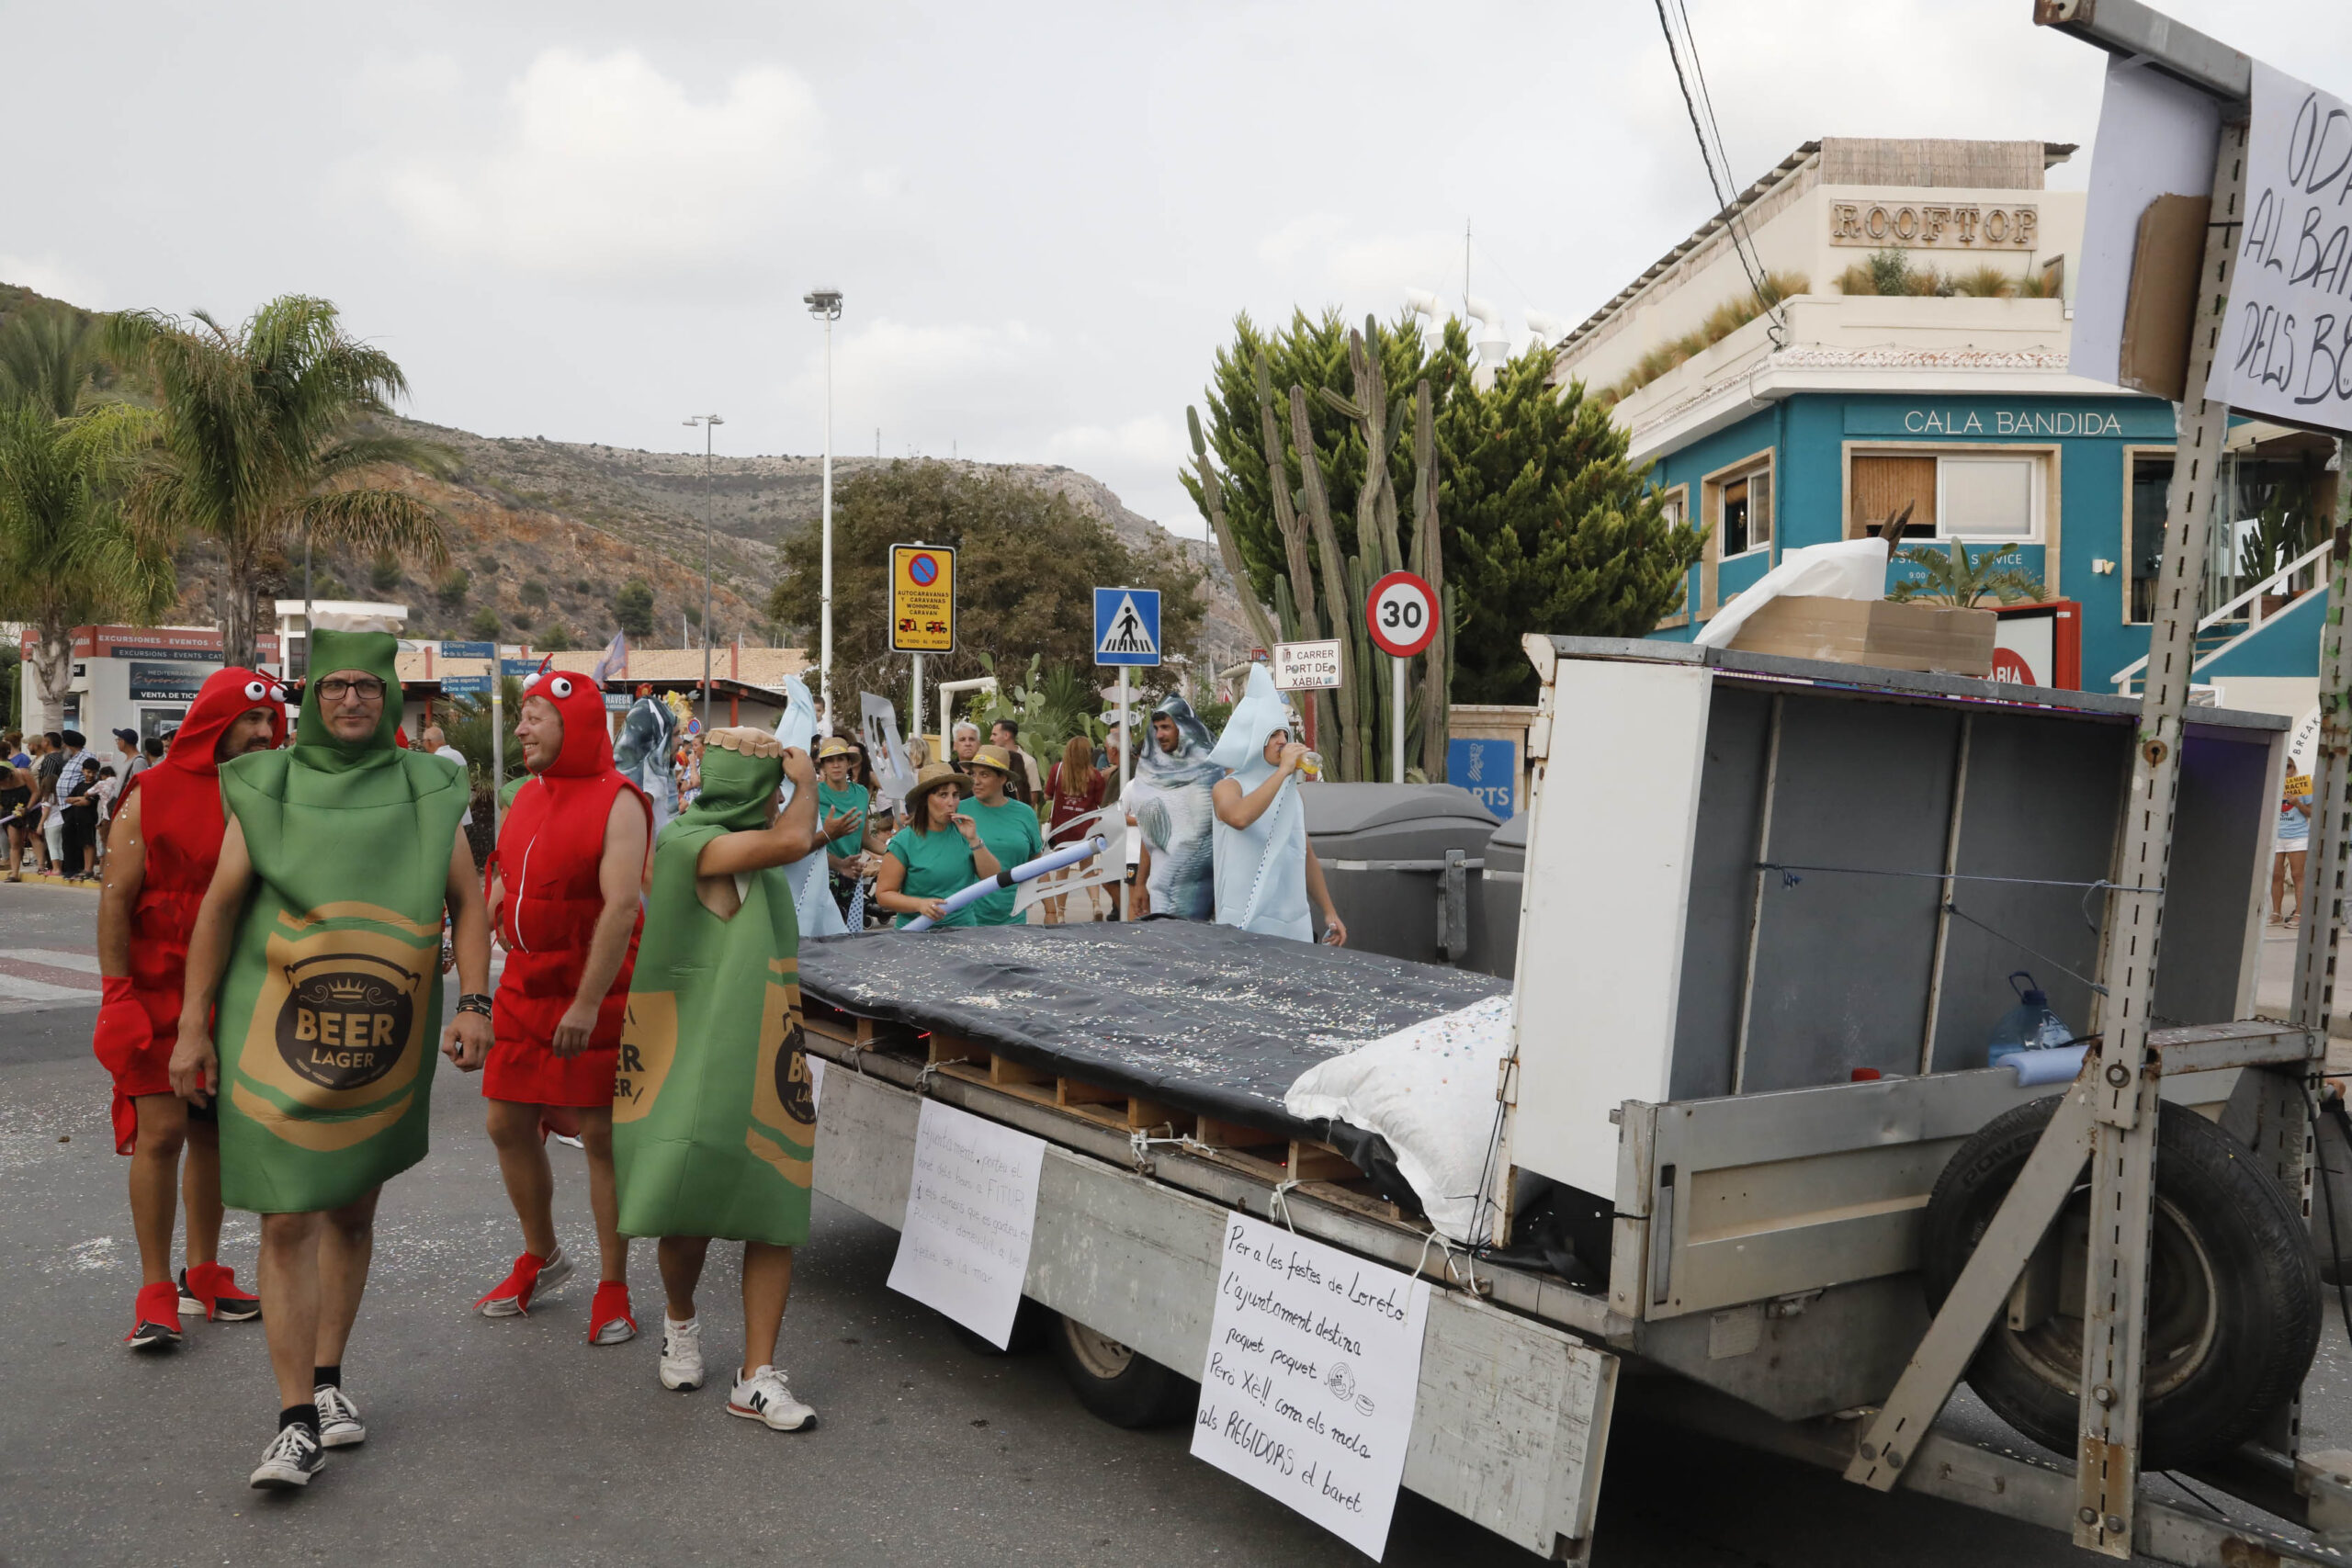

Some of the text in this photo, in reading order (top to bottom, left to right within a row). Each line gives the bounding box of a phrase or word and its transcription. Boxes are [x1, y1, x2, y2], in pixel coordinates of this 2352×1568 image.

[1834, 204, 2037, 243] ROOFTOP
[2245, 187, 2285, 274] AL
[2234, 300, 2295, 393] DELS
[1905, 411, 2121, 434] CALA BANDIDA
[1383, 601, 1422, 628] 30
[98, 635, 161, 644] EXCURSIONES
[1296, 649, 1334, 660] CARRER
[1316, 663, 1329, 672] DE
[1978, 666, 2022, 684] ABIA
[1292, 674, 1323, 687] XÀBIA
[605, 694, 630, 704] NAVEGA
[2292, 716, 2322, 755] BREAK
[1473, 787, 1510, 806] RTS
[2284, 782, 2308, 790] RACTE
[294, 1008, 395, 1047] BEER
[311, 1047, 374, 1068] LAGER
[967, 1205, 980, 1221] que
[1227, 1225, 1404, 1321] Per a les festes de Loreto
[1315, 1311, 1362, 1356] destina
[1225, 1326, 1318, 1379] poquet poquet
[749, 1390, 768, 1414] N
[1198, 1404, 1217, 1431] als
[1224, 1410, 1295, 1476] REGIDORS
[1302, 1461, 1315, 1487] el
[1306, 1410, 1325, 1437] els
[1331, 1423, 1371, 1459] mola
